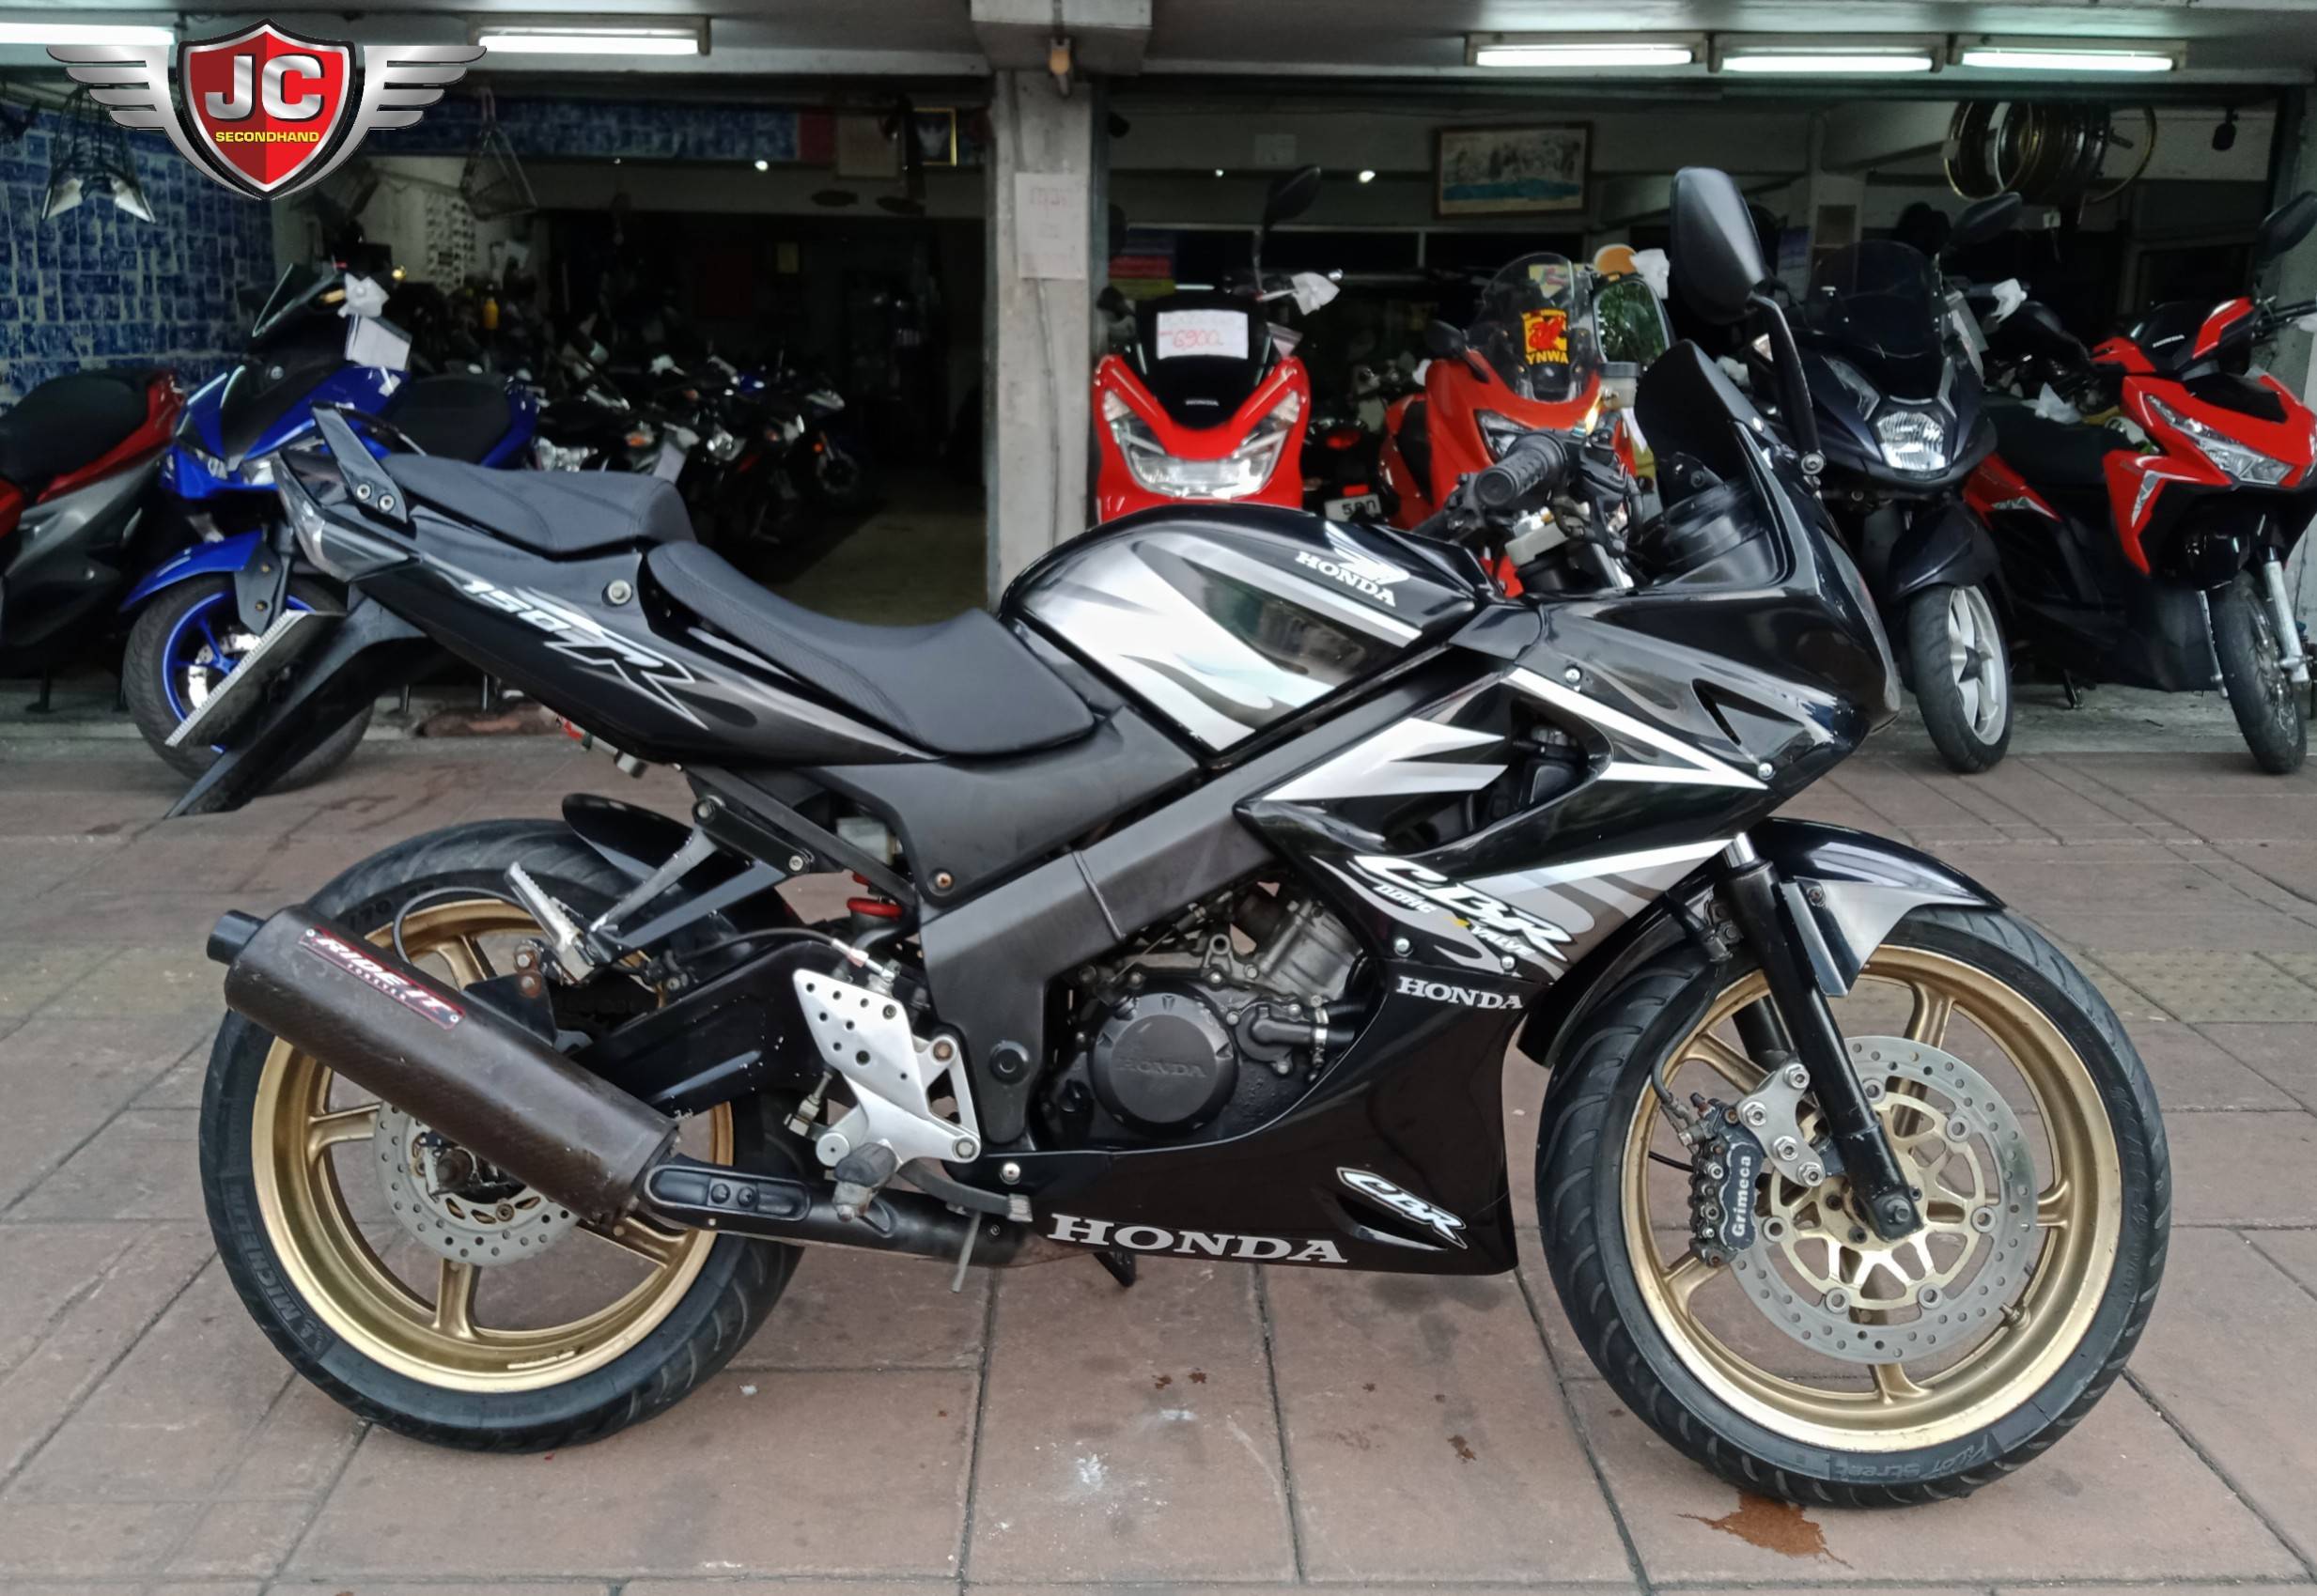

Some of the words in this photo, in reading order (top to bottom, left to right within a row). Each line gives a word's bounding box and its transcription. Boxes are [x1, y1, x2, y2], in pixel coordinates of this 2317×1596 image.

[1526, 350, 1570, 365] YNWA
[1295, 550, 1396, 607] HONDA
[1354, 855, 1575, 962] CBR
[1470, 925, 1536, 955] VALVE
[315, 937, 412, 985] RIDE
[404, 989, 454, 1013] IT
[1396, 975, 1524, 1010] HONDA
[1339, 1168, 1467, 1248] CBR
[1732, 1155, 1751, 1237] Grimeca
[1048, 1213, 1347, 1263] HONDA
